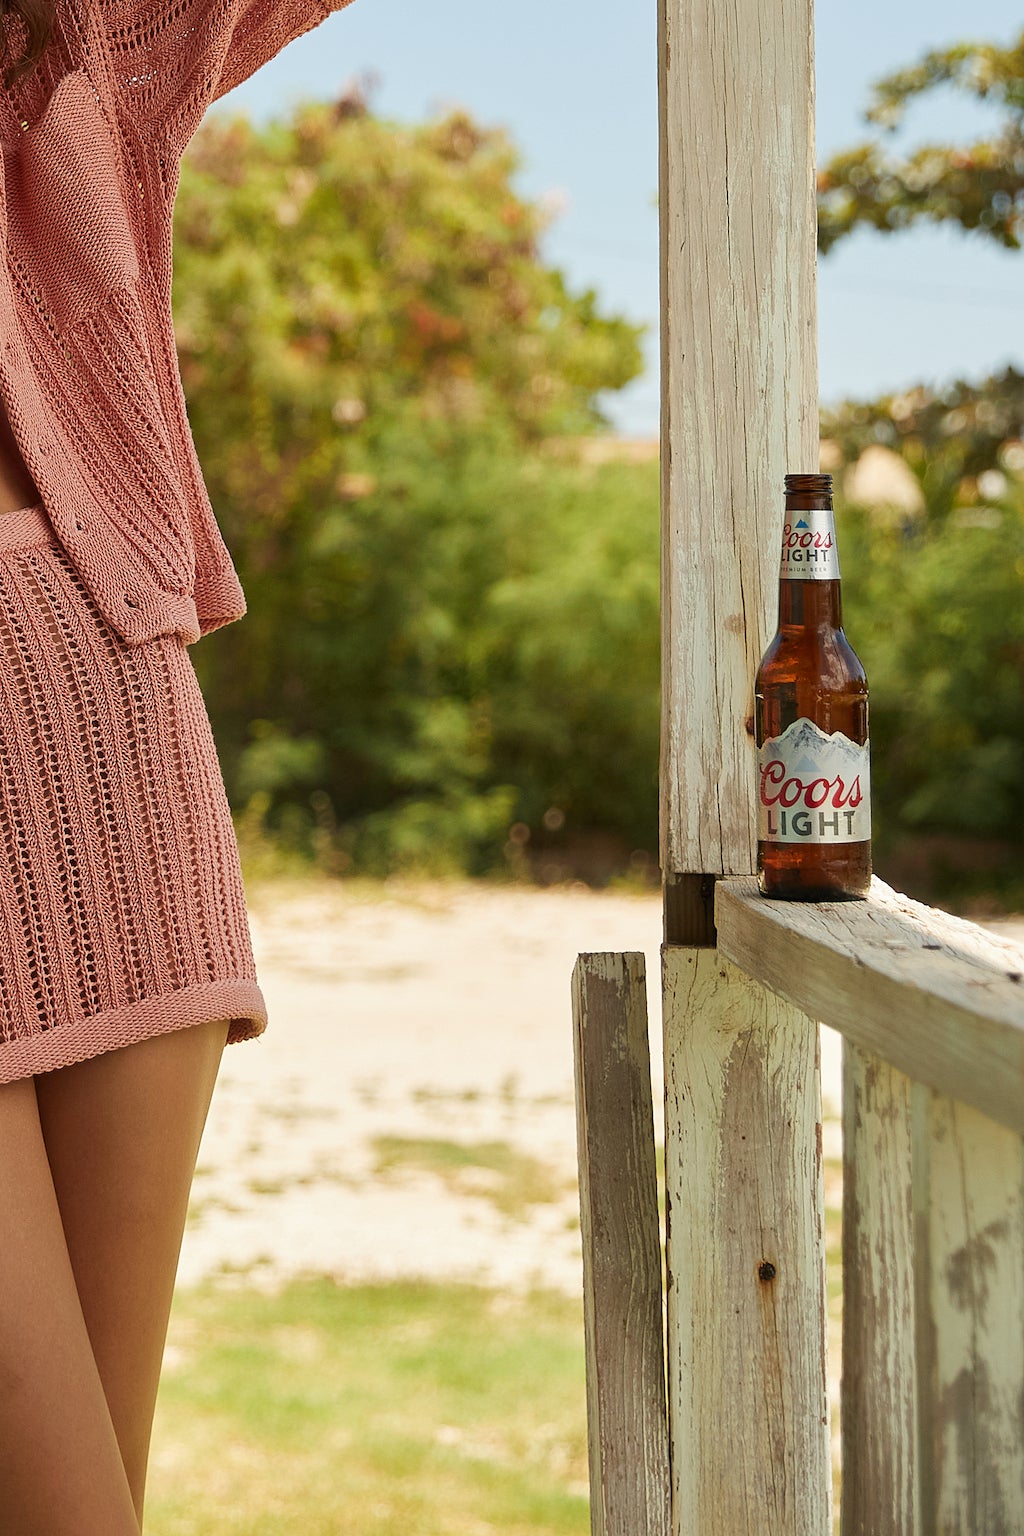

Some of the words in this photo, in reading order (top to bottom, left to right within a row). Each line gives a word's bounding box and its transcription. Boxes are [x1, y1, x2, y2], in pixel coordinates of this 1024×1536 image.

[782, 524, 833, 548] Coors
[781, 549, 828, 562] LIGHT
[760, 760, 863, 809] Coors
[768, 810, 856, 836] LIGHT
